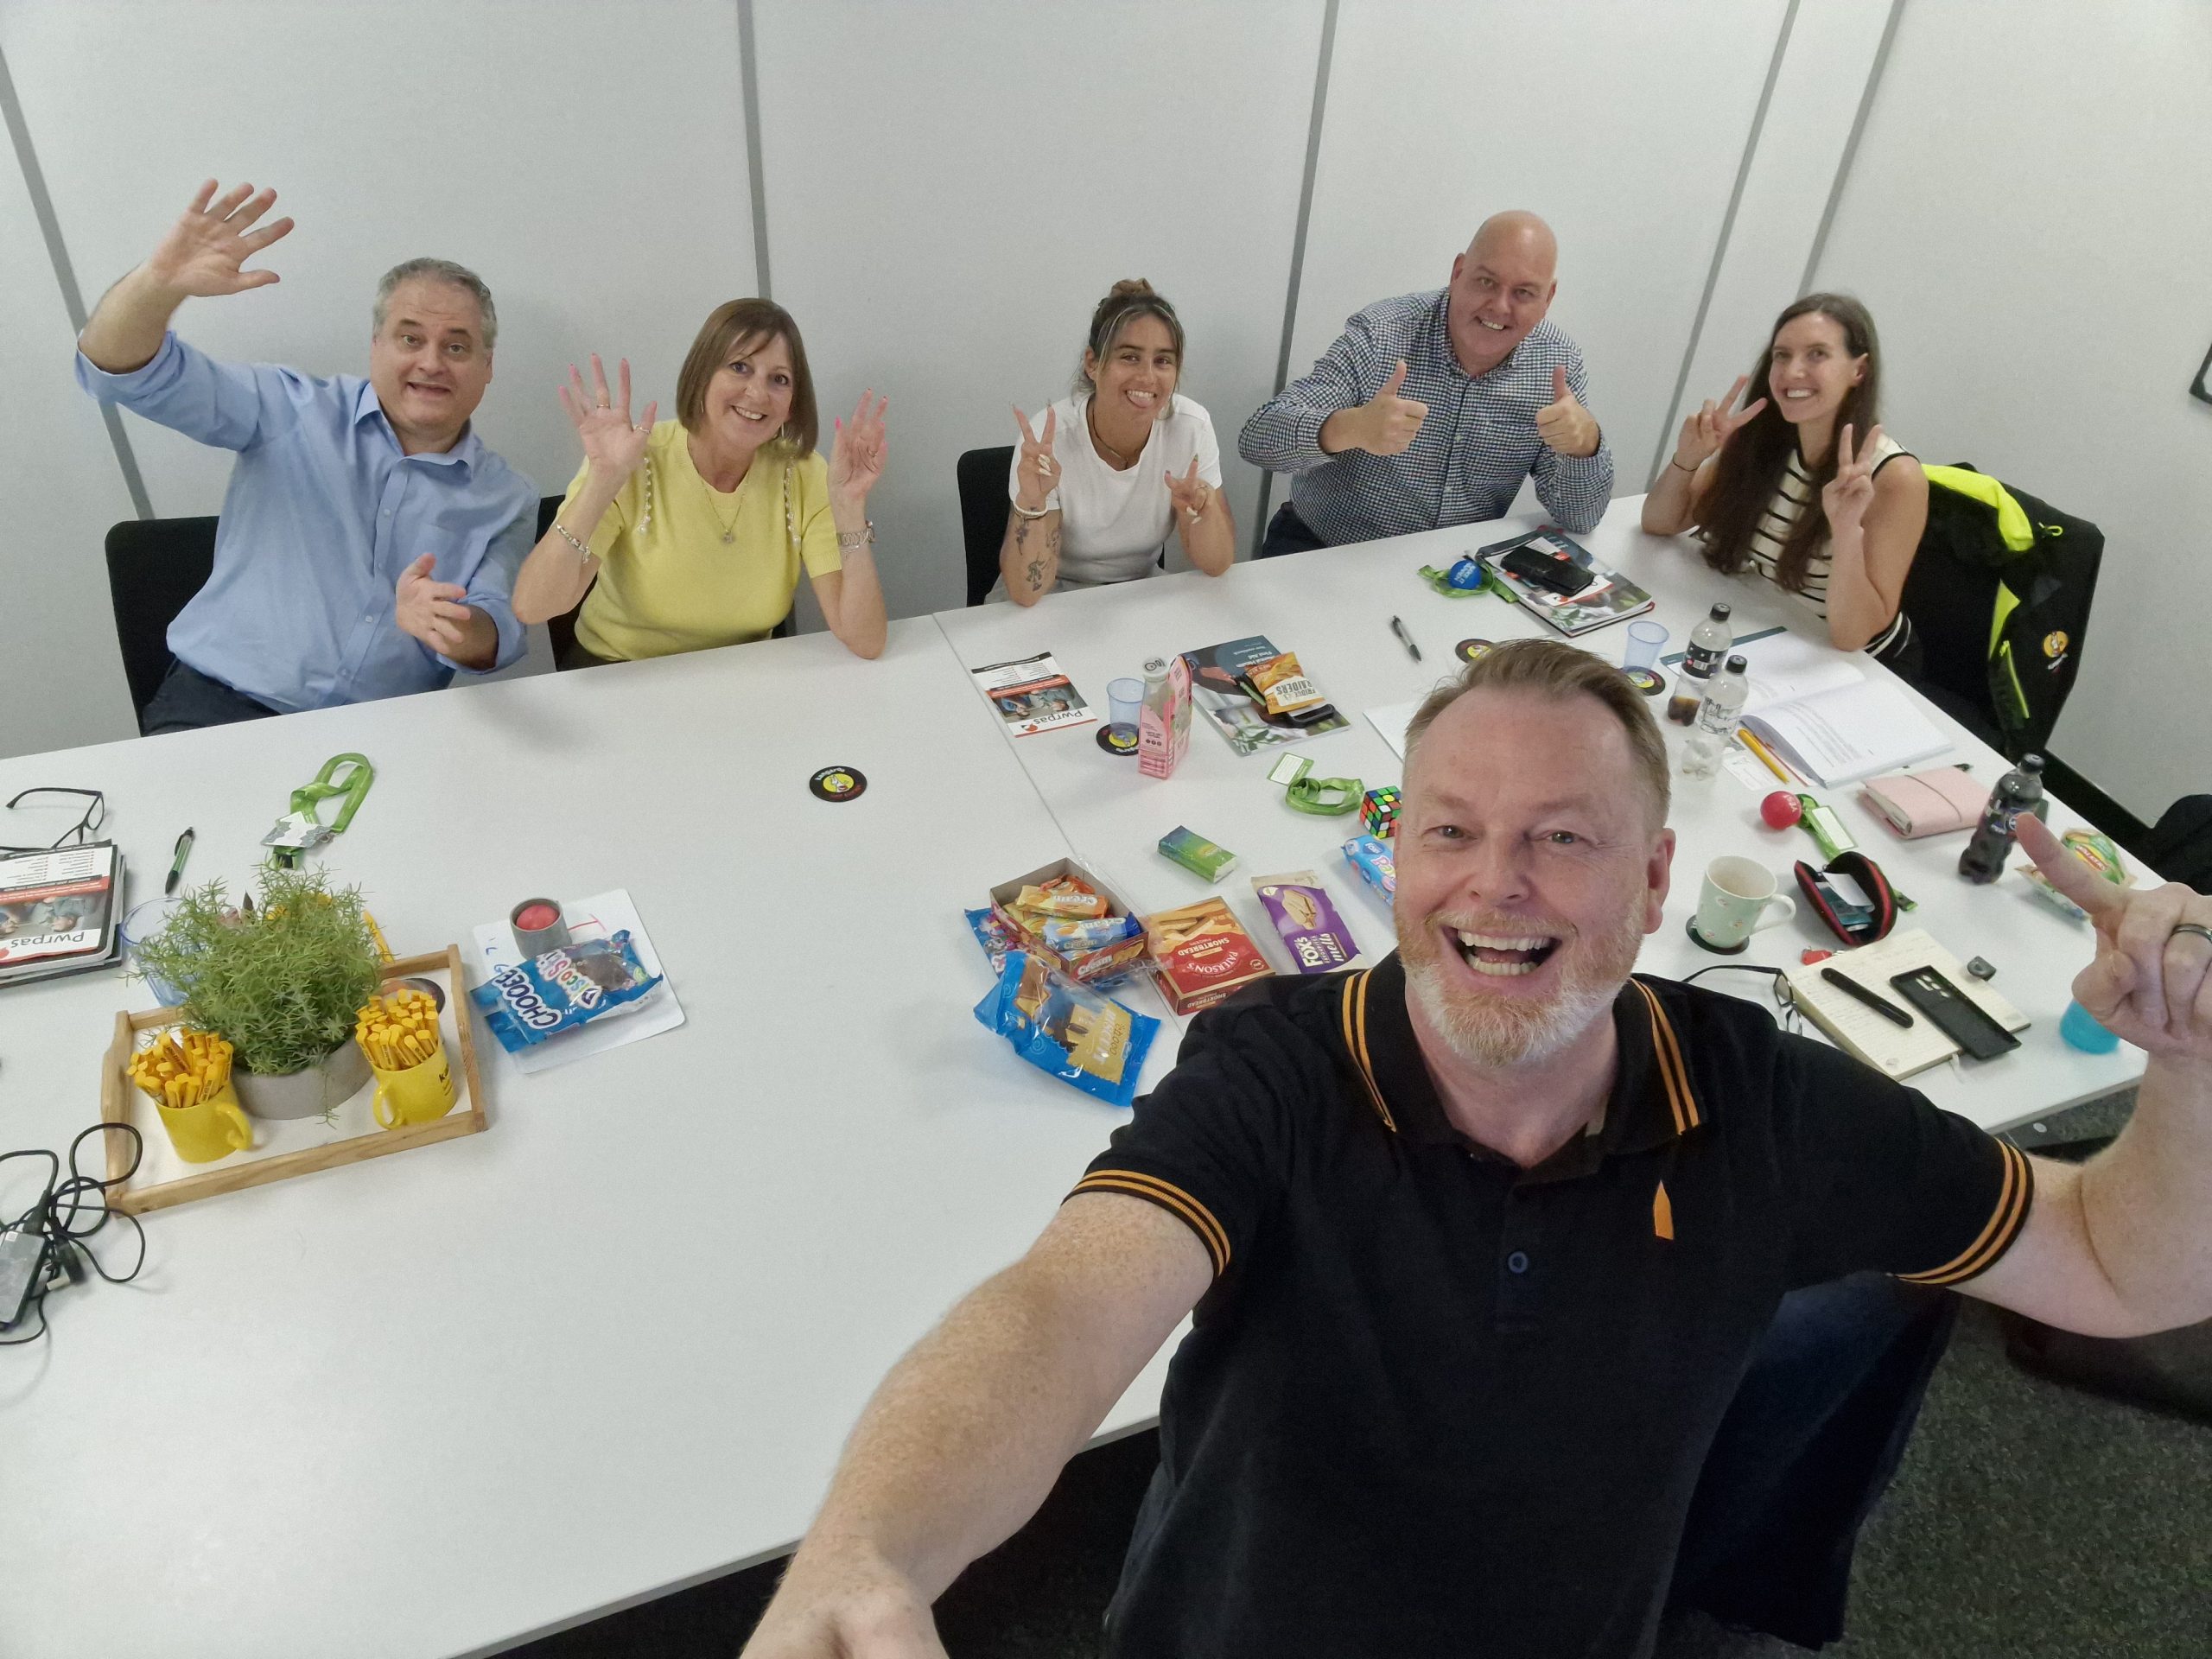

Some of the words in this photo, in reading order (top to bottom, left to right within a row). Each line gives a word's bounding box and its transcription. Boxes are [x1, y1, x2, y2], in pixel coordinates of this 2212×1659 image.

[1275, 680, 1312, 695] RAIDERS
[1033, 709, 1083, 725] Pwrpas
[10, 932, 85, 948] Pwrpas
[1178, 938, 1230, 956] SHORTBREAD
[1187, 951, 1237, 972] PATERSON'S
